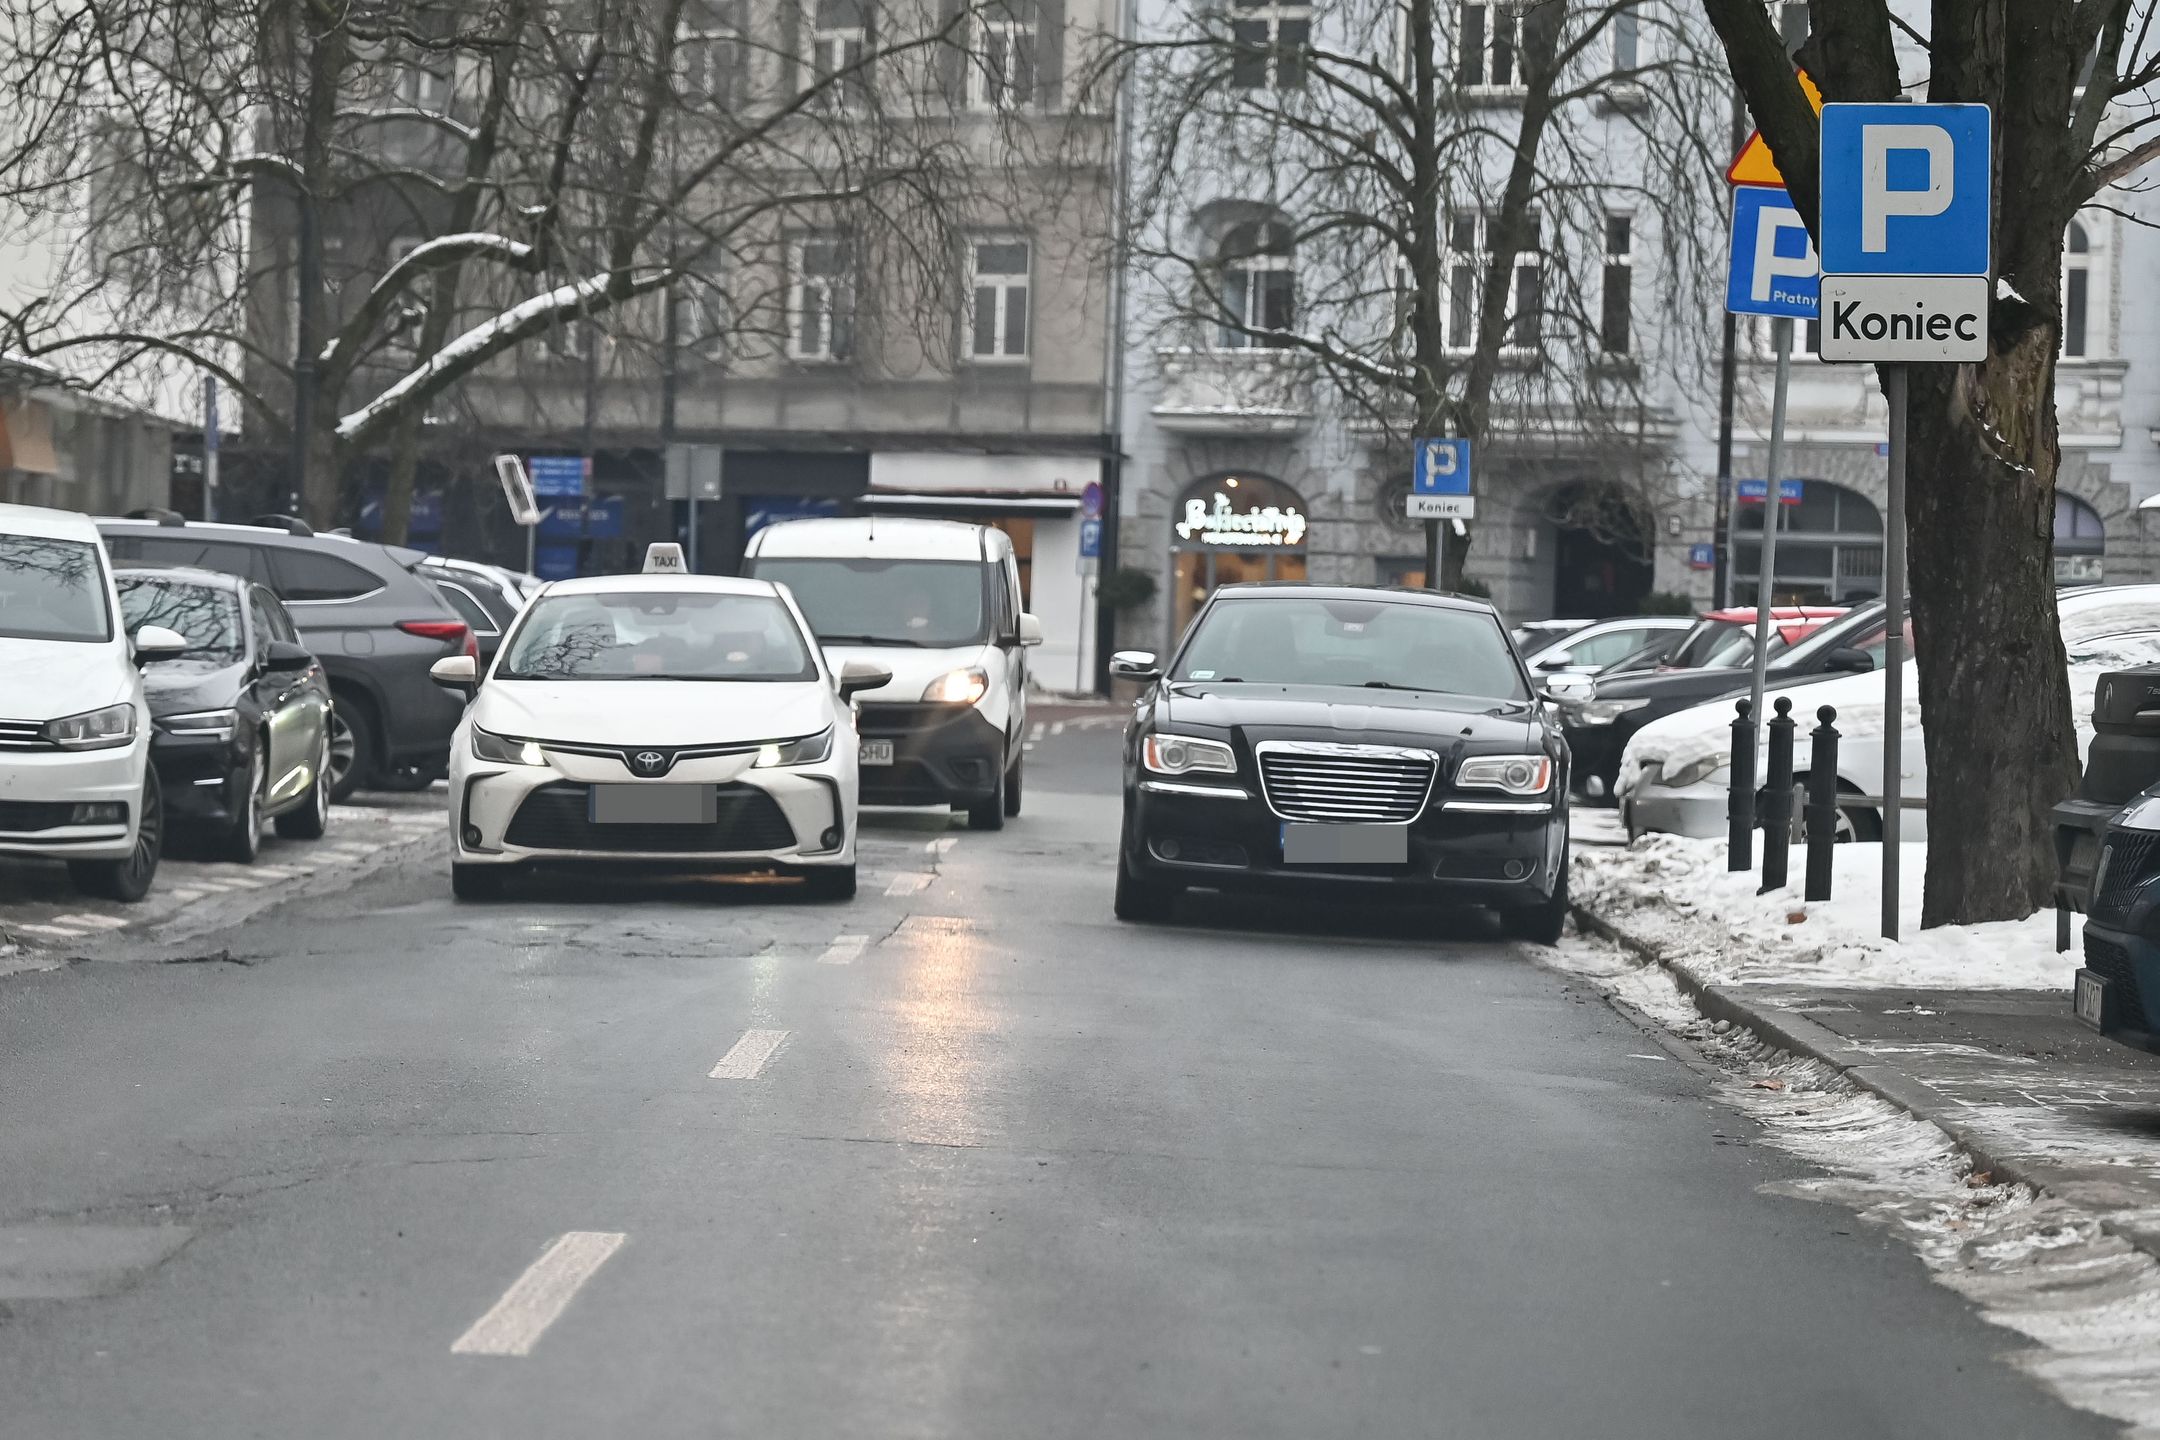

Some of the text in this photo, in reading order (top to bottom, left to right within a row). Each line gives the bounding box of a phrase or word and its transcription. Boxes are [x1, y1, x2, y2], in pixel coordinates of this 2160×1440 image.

[1862, 124, 1954, 252] P
[1751, 206, 1819, 302] P
[1773, 290, 1818, 309] Płatny
[1832, 301, 1978, 342] Koniec
[1426, 444, 1457, 488] P
[1418, 501, 1460, 513] Koniec
[652, 556, 677, 568] TAXI
